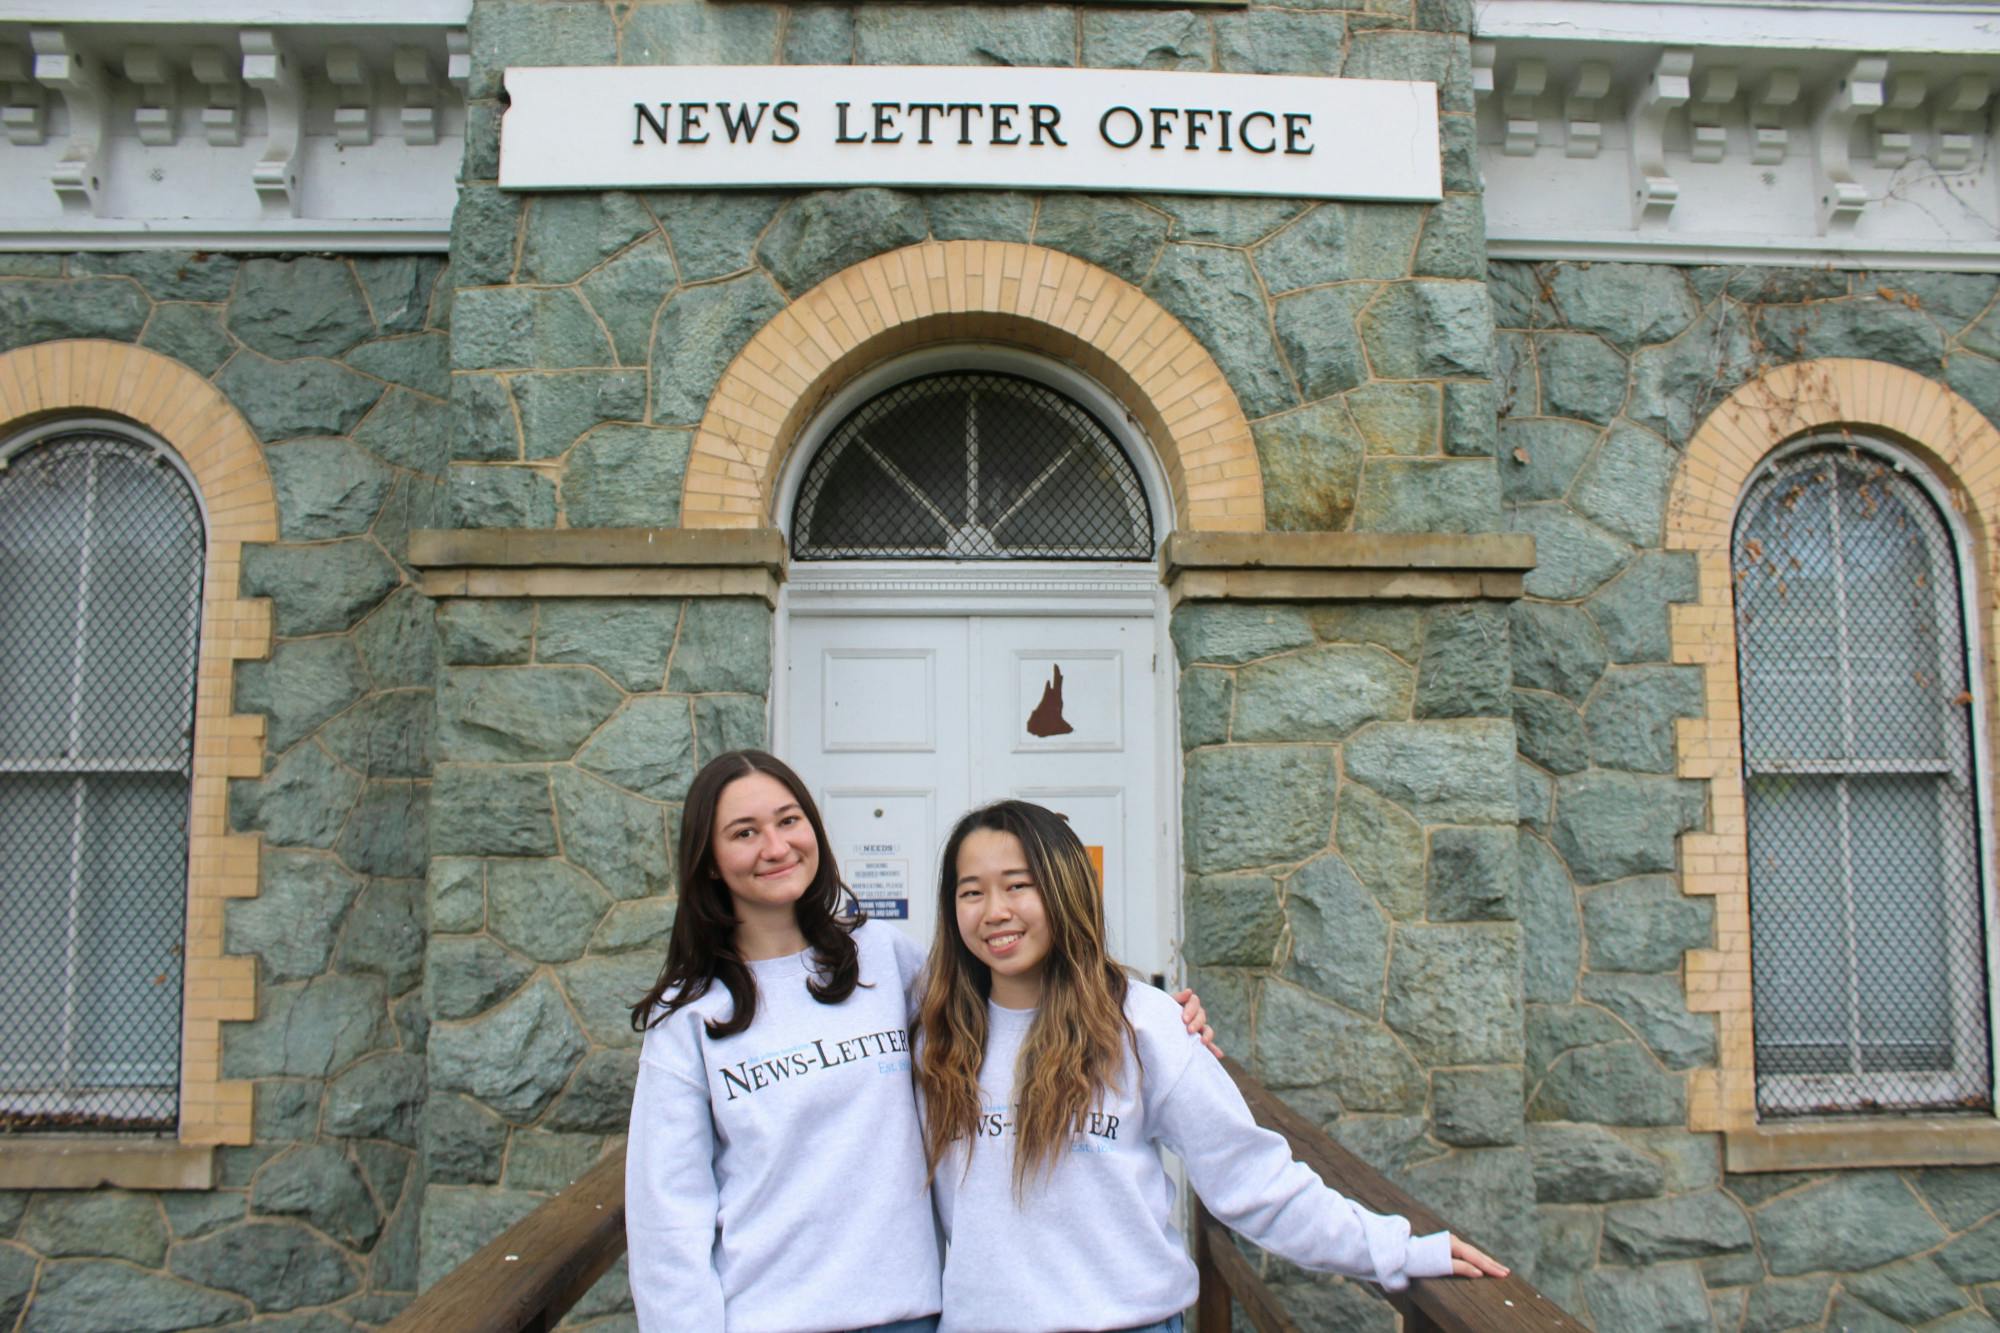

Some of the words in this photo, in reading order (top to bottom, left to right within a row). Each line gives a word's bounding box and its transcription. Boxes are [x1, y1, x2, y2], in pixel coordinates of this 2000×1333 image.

[632, 101, 802, 147] NEWS
[835, 102, 1069, 148] LETTER
[1098, 105, 1315, 156] OFFICE
[718, 1029, 909, 1101] NEWS-LETTER
